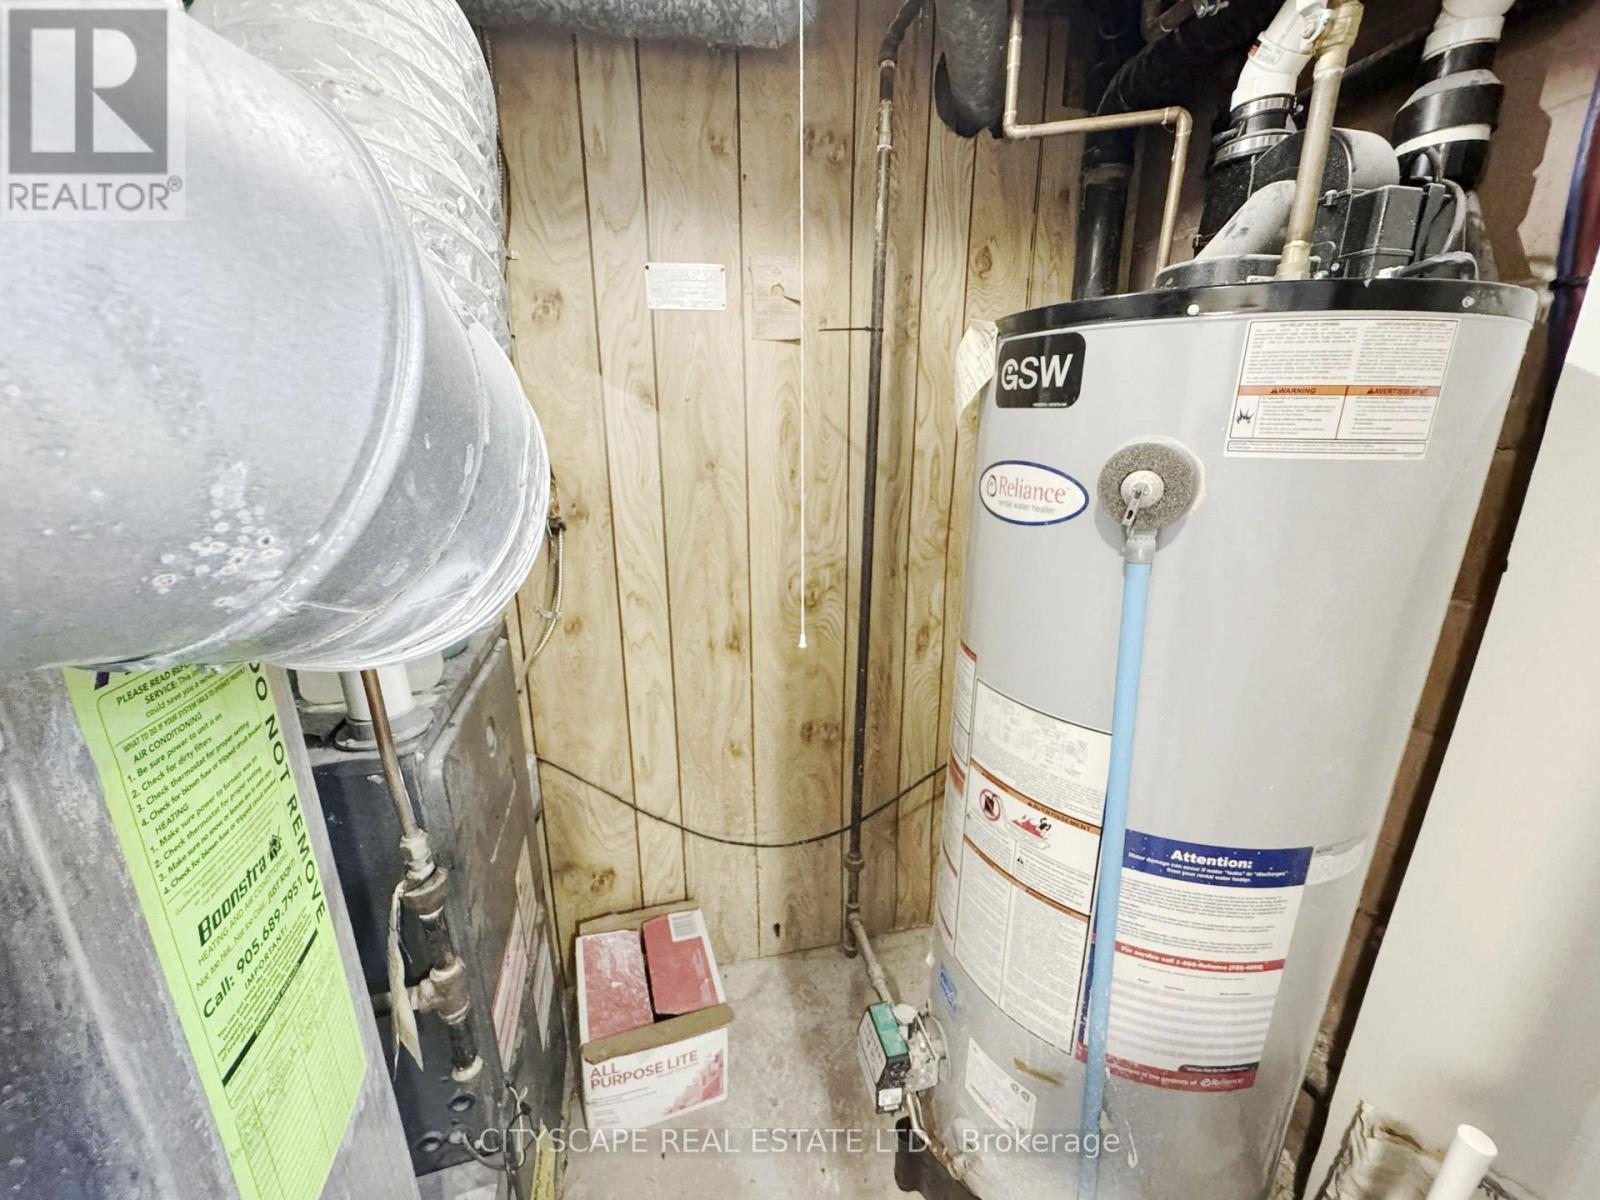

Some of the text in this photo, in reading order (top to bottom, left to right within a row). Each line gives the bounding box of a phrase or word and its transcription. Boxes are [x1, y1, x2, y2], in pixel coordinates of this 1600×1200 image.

[1001, 353, 1073, 391] GSW
[999, 475, 1066, 504] Reliance
[1013, 502, 1030, 511] water
[1031, 504, 1056, 514] heater
[116, 683, 149, 706] PLEASE
[149, 671, 171, 688] READ
[145, 702, 166, 718] could
[166, 691, 182, 705] save
[182, 683, 195, 699] you
[122, 737, 141, 753] WHAT
[140, 731, 150, 742] TO
[149, 725, 159, 738] DO
[164, 712, 178, 726] YOUR
[134, 711, 202, 763] AIR CONDITIONING
[137, 766, 148, 777] Be
[150, 754, 166, 769] sure
[167, 738, 188, 760] power
[189, 732, 197, 740] to
[198, 722, 209, 735] unit
[215, 713, 223, 721] on
[132, 737, 212, 799] 2. Check for dirty filters
[135, 803, 145, 813] 3.
[146, 786, 170, 805] Check
[170, 757, 206, 788] thermostat
[206, 749, 216, 760] for
[216, 735, 233, 753] proper
[149, 801, 171, 820] Check
[170, 794, 182, 804] for
[181, 778, 200, 796] blown
[200, 768, 212, 781] fuse
[159, 827, 180, 847] Make
[181, 813, 196, 829] sure
[196, 796, 215, 817] power
[215, 789, 223, 797] to
[223, 771, 242, 790] furnace
[155, 802, 189, 834] HEATING
[163, 838, 186, 860] Check
[187, 806, 220, 840] thermostat
[220, 798, 229, 807] for
[229, 781, 246, 801] proper
[265, 713, 291, 782] NOT
[287, 793, 326, 924] REMOVE
[167, 854, 187, 873] Make
[187, 841, 201, 856] sure
[201, 833, 209, 843] no
[209, 820, 223, 836] snow
[170, 866, 191, 888] Check
[191, 857, 202, 869] for
[201, 840, 219, 860] blown
[218, 829, 230, 843] fuse
[1146, 857, 1170, 867] damage
[1170, 849, 1253, 869] Attention:
[267, 880, 280, 904] JUST
[1166, 867, 1181, 876] from
[1181, 870, 1197, 878] your
[1196, 873, 1214, 881] rental
[1215, 874, 1231, 882] water
[198, 855, 267, 948] Boonstra
[198, 927, 229, 966] HEATING
[229, 907, 245, 931] AND
[203, 976, 235, 1018] Call:
[237, 875, 303, 975] 905.689.7951
[244, 925, 288, 991] IMPORTANT!
[1161, 957, 1175, 965] call
[590, 1061, 665, 1090] PURPOSE
[667, 1049, 699, 1070] LITE
[590, 1062, 621, 1079] ALL
